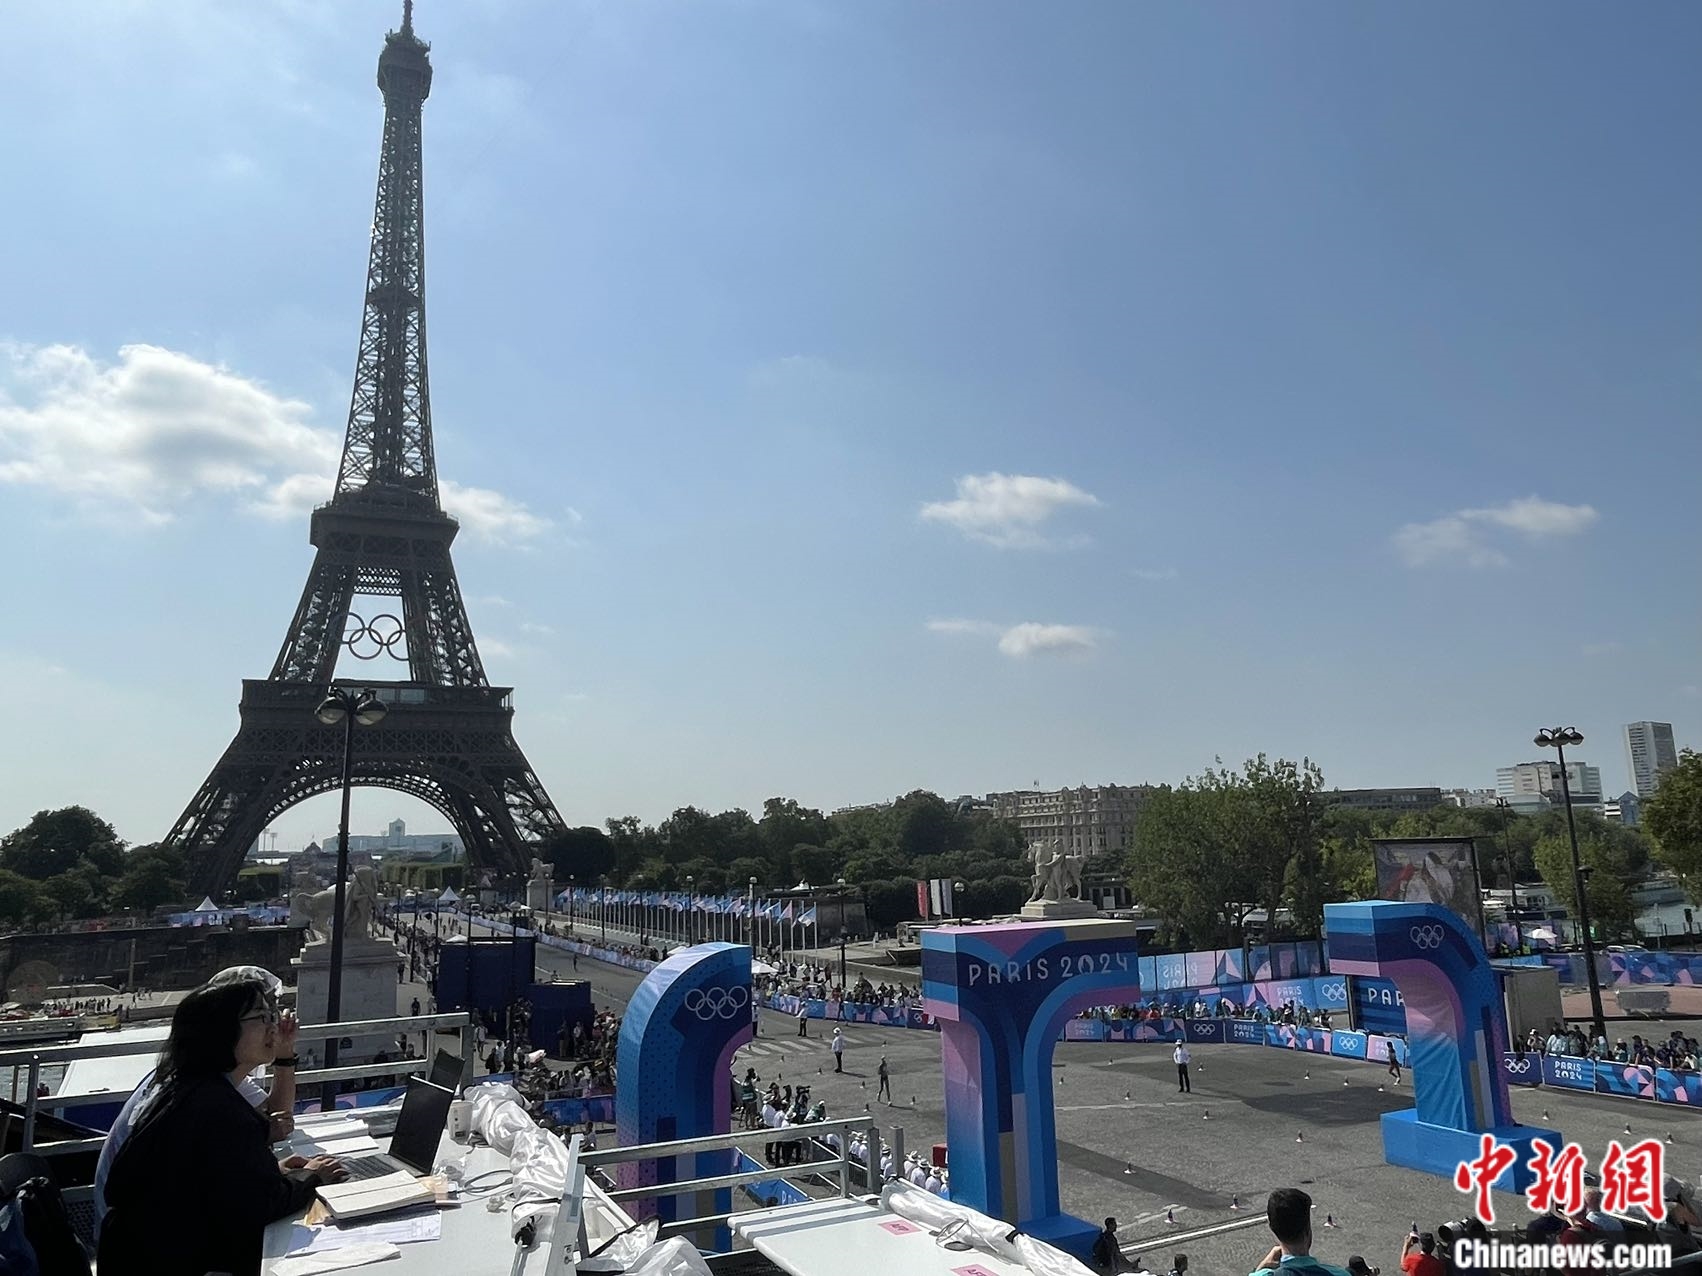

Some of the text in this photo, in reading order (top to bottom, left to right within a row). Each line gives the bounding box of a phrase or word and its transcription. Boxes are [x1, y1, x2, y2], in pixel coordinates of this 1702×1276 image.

[969, 952, 1128, 986] PARIS 2024
[1554, 1060, 1582, 1071] PARIS
[1554, 1069, 1582, 1080] 2024
